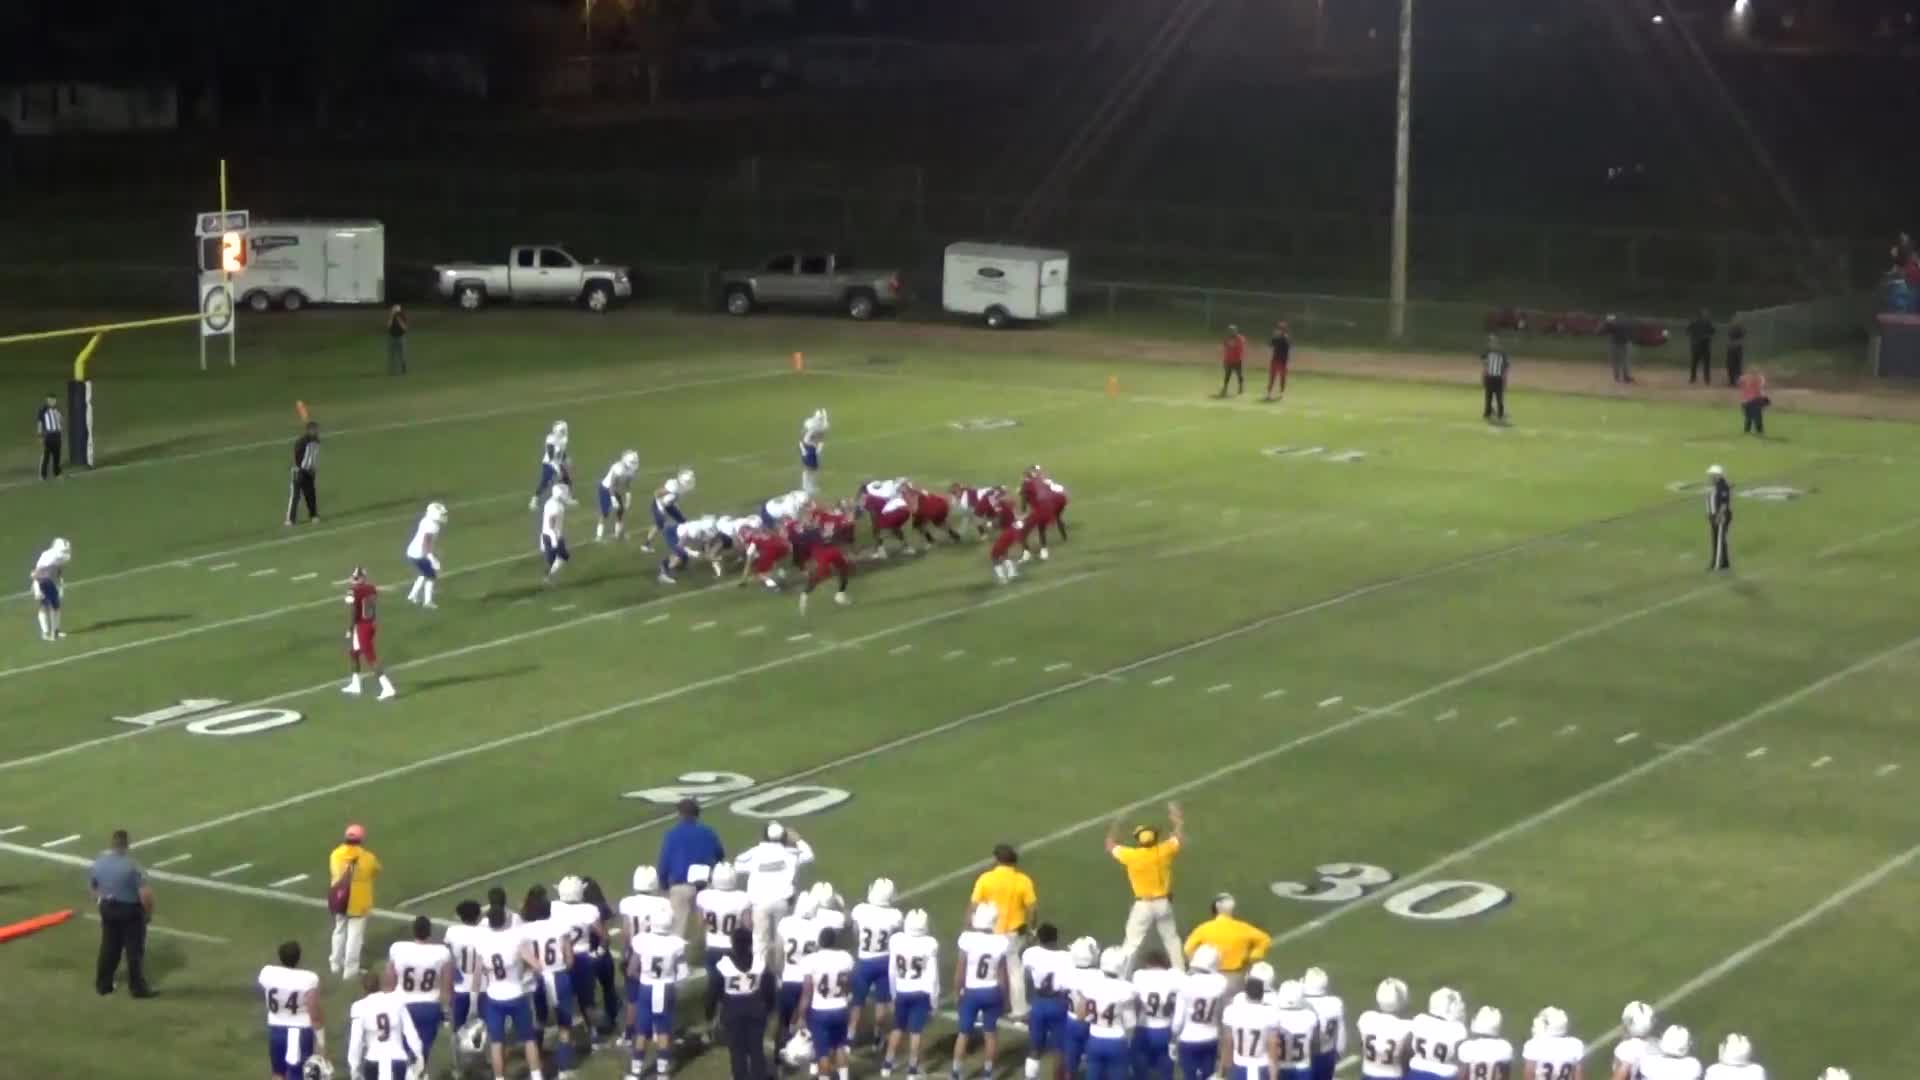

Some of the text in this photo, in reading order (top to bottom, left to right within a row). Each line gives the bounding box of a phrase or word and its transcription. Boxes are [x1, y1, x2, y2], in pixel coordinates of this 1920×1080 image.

[112, 699, 302, 735] 10
[621, 771, 852, 818] 20
[1270, 862, 1508, 920] 30
[402, 967, 437, 992] 68
[491, 953, 506, 980] 8
[650, 956, 664, 979] 5
[975, 953, 992, 979] 6
[817, 972, 849, 998] 45
[267, 987, 299, 1015] 64
[375, 1012, 391, 1042] 9
[1237, 1027, 1262, 1058] 17
